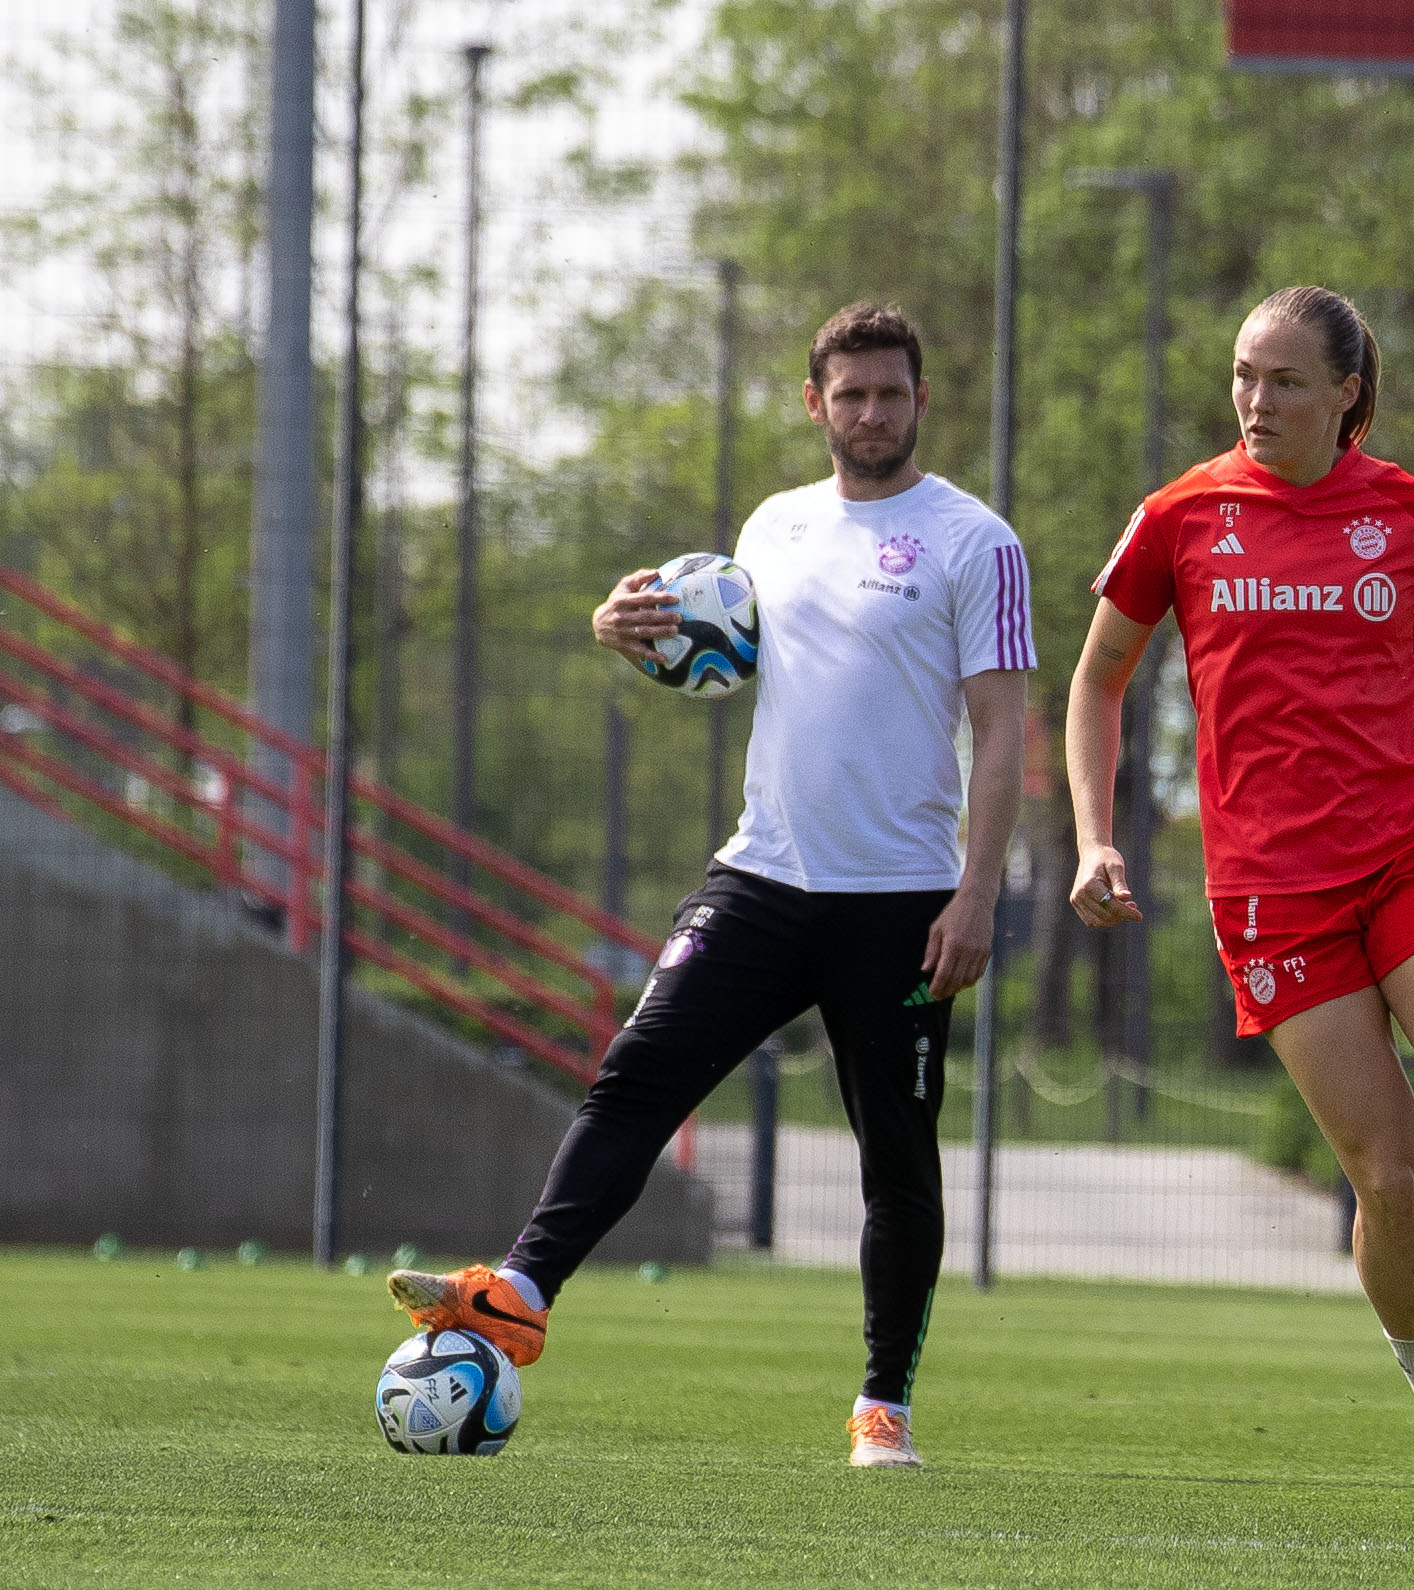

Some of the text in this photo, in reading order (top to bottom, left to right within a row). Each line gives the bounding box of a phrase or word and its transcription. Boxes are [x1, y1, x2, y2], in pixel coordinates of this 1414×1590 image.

[1219, 503, 1241, 516] FF1
[1225, 516, 1234, 528] 5
[857, 579, 901, 596] Allianz
[1211, 578, 1343, 612] Allianz
[1283, 956, 1306, 972] FF1
[1295, 970, 1305, 983] 5
